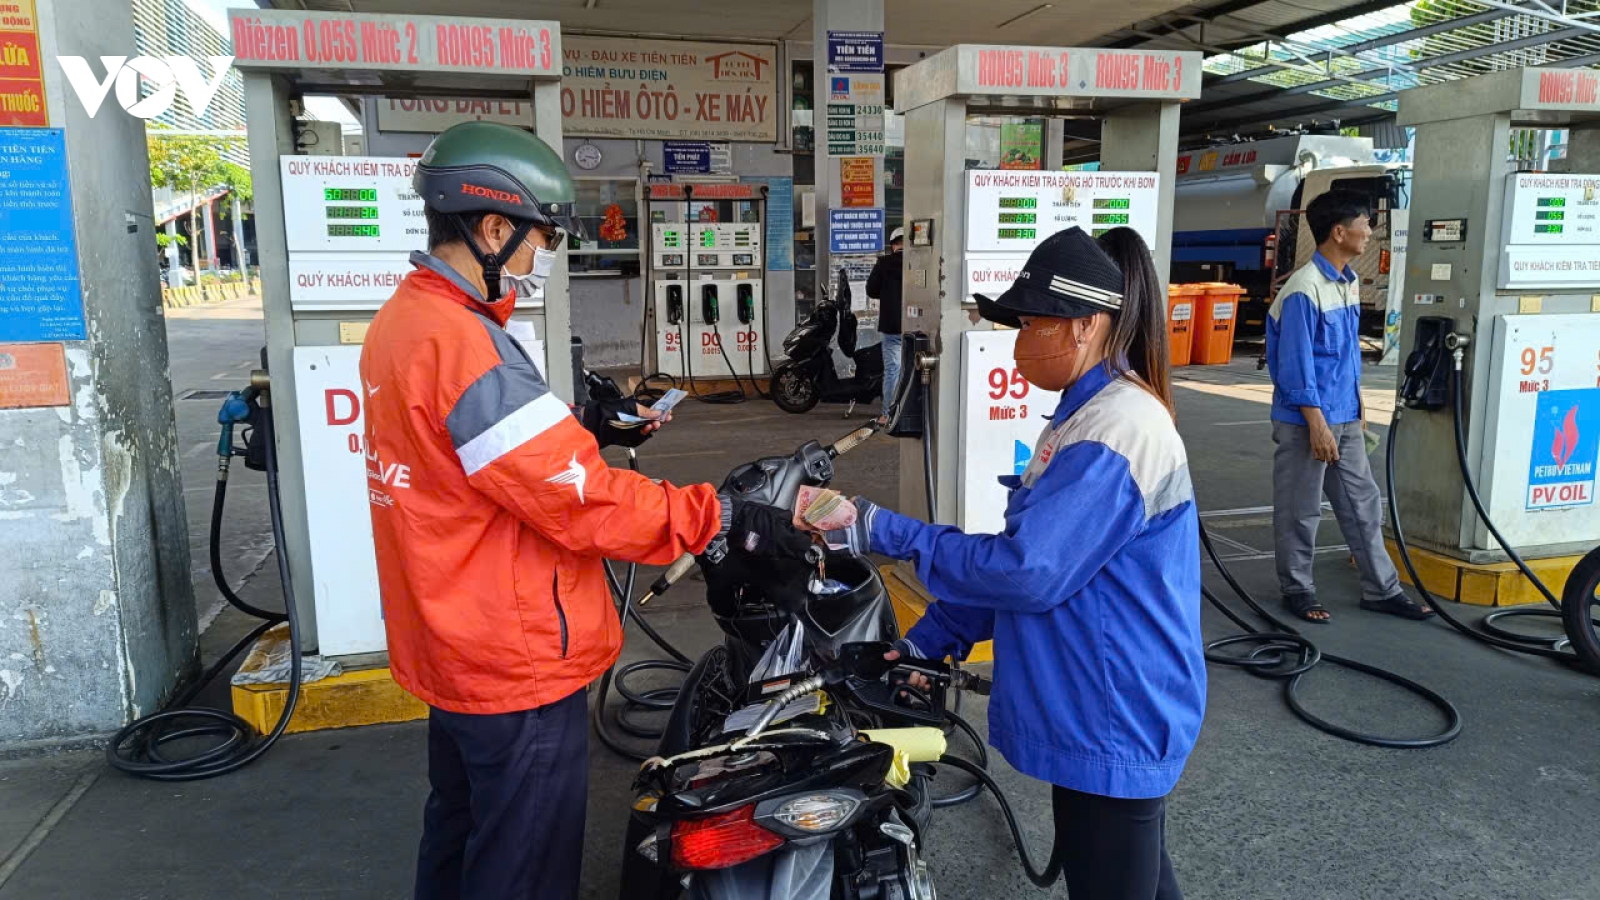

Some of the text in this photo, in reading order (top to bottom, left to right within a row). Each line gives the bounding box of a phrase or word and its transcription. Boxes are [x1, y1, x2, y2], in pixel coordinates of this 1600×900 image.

[304, 19, 357, 65] 0,05S
[361, 21, 401, 64] Mức
[405, 23, 418, 64] 2
[437, 24, 551, 70] RON95 Mức 3
[563, 49, 580, 61] VỤ
[622, 52, 636, 62] XE
[978, 49, 1068, 88] RON95 Mức 3
[1096, 53, 1182, 91] RON95 Mức 3
[1539, 71, 1598, 103] RON95 Mức
[581, 82, 631, 120] HIỂM
[636, 83, 679, 121] ÔTÔ
[696, 93, 720, 122] XE
[726, 87, 768, 123] MÁY
[313, 159, 351, 176] KHÁCH
[381, 163, 402, 177] TRA
[993, 172, 1020, 187] KHÁCH
[1042, 175, 1057, 187] TRA
[1124, 176, 1135, 188] KHI
[461, 182, 522, 205] HONDA
[327, 270, 370, 287] KHÁCH
[994, 266, 1020, 282] KHÁC
[665, 332, 680, 345] 95
[702, 332, 721, 346] DO
[736, 331, 758, 344] DO
[1520, 346, 1554, 376] 95
[988, 367, 1029, 400] 95
[1519, 379, 1549, 393] Mức 3
[325, 388, 360, 426] D
[989, 404, 1028, 421] Mức 3
[1534, 462, 1591, 478] PETROVIETNAM
[1532, 484, 1587, 504] PV OIL
